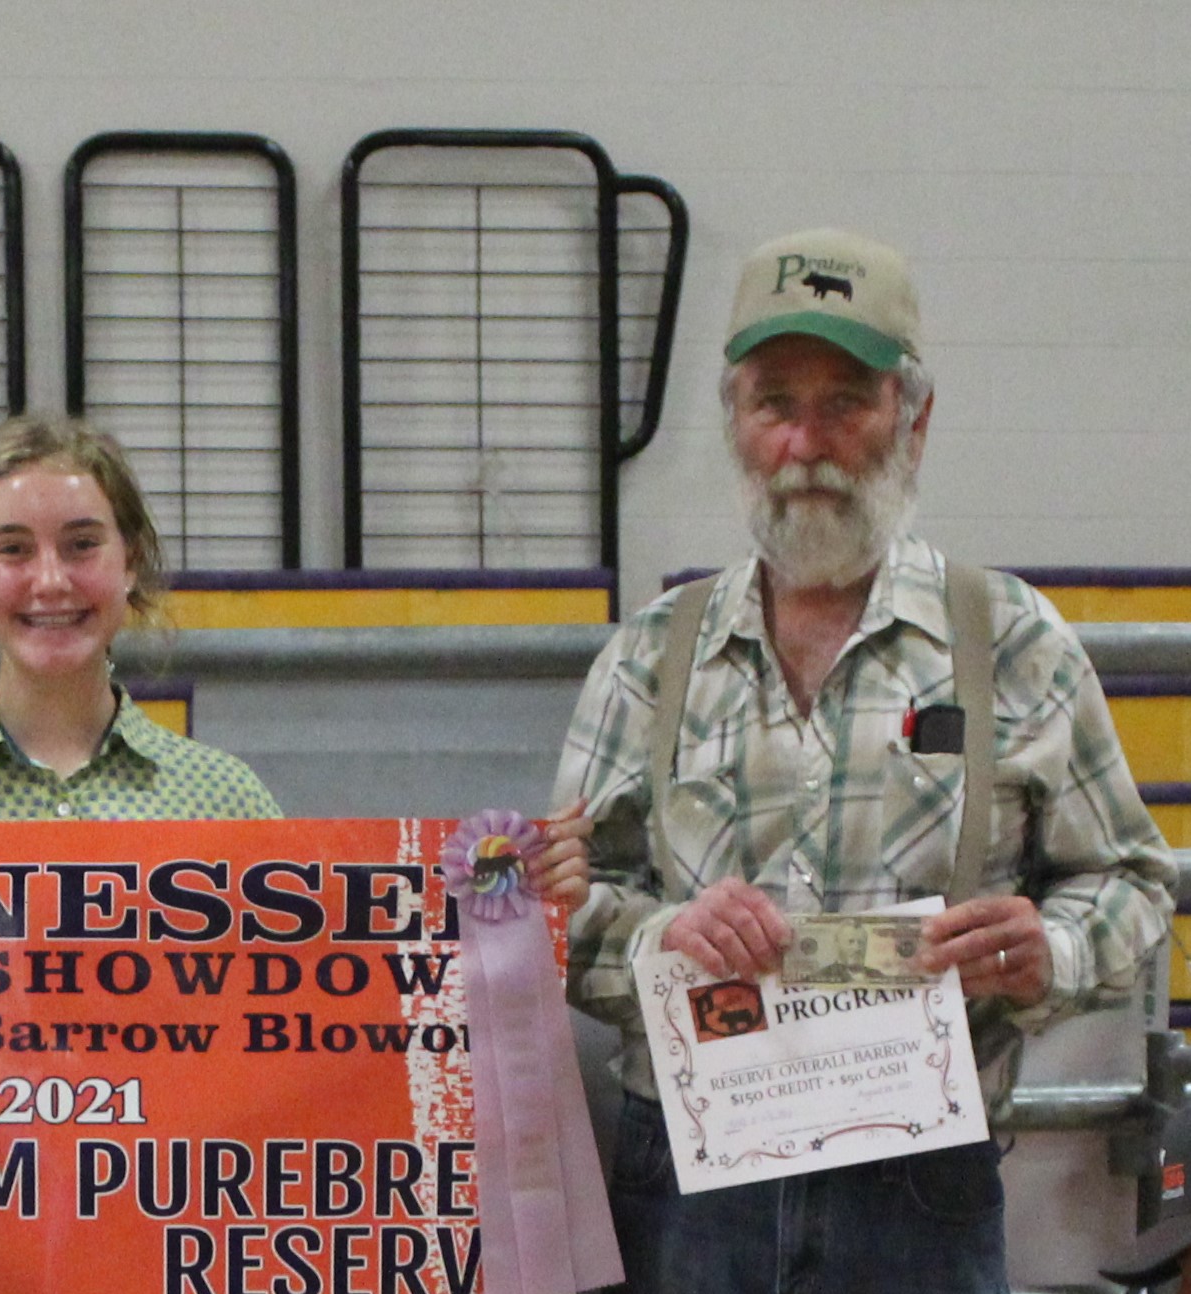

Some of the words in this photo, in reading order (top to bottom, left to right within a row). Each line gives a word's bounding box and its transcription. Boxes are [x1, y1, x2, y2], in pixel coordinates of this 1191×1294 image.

[775, 987, 916, 1024] PROGRAM
[709, 1071, 776, 1092] RESERVE
[778, 1056, 851, 1082] OVERALL
[853, 1040, 922, 1064] BARROW
[730, 1089, 764, 1107] $150
[766, 1075, 825, 1099] CREDIT
[866, 1061, 909, 1081] CASH
[75, 1138, 476, 1221] PUREBRE
